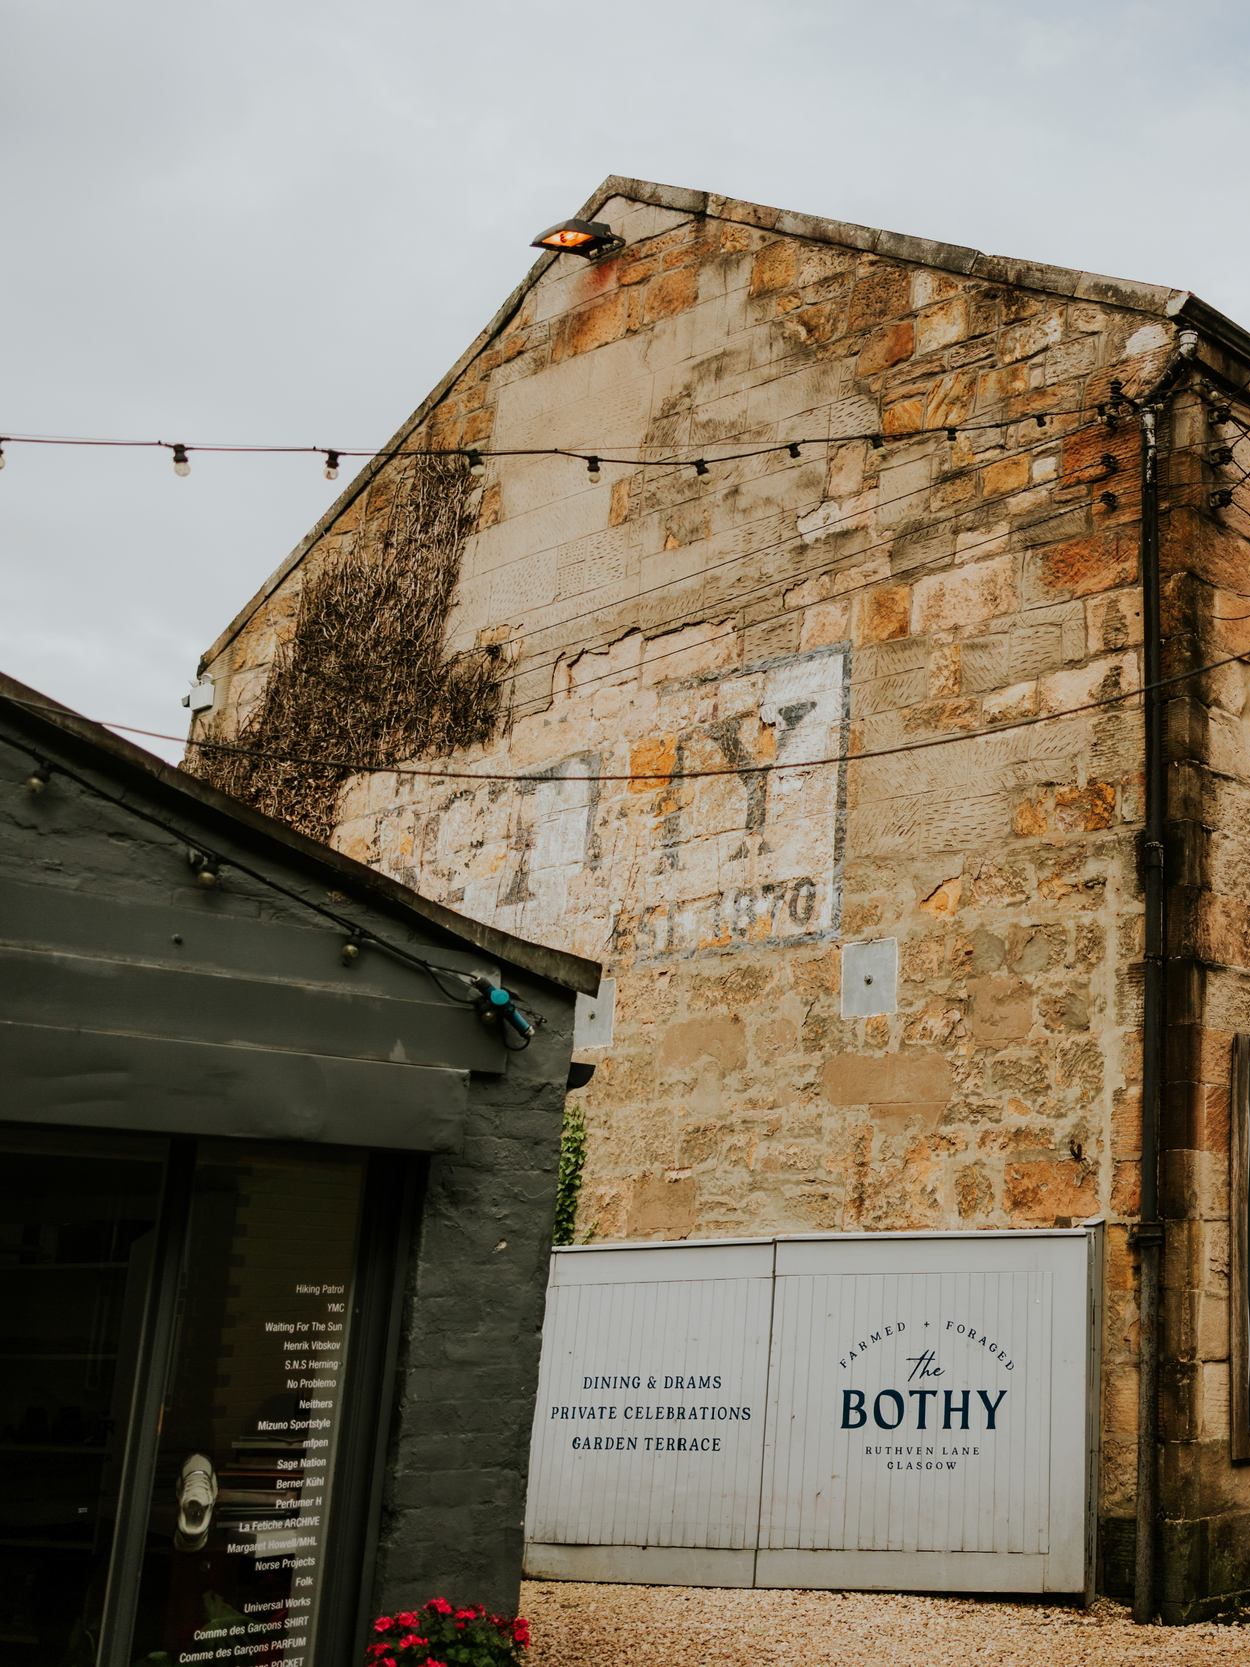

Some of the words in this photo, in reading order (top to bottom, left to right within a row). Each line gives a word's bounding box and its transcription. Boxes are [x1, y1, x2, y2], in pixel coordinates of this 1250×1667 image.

[295, 1284, 321, 1296] Hiking
[321, 1284, 345, 1294] Patrol
[327, 1303, 345, 1313] YMC
[264, 1321, 295, 1334] Waiting
[296, 1321, 310, 1331] For
[311, 1321, 326, 1331] The
[327, 1321, 343, 1331] Sun
[283, 1340, 310, 1351] Henrik
[311, 1340, 341, 1351] Vibskov
[839, 1321, 907, 1369] FARMED
[945, 1320, 1015, 1372] FORAGED
[284, 1359, 307, 1370] S.N.S
[308, 1359, 339, 1371] Herning
[905, 1349, 946, 1382] the
[286, 1379, 299, 1389] No
[299, 1379, 337, 1389] Problemo
[582, 1375, 642, 1390] DINING
[646, 1375, 658, 1389] &
[663, 1375, 723, 1389] DRAMS
[299, 1399, 334, 1410] Neithers
[840, 1388, 1008, 1430] BOTHY
[550, 1406, 618, 1420] PRIVATE
[623, 1406, 752, 1421] CELEBRATIONS
[257, 1420, 289, 1431] Mizuno
[289, 1418, 331, 1430] Sportstyle
[302, 1438, 329, 1449] mfpen
[571, 1436, 638, 1450] GARDEN
[643, 1437, 722, 1451] TERRACE
[865, 1446, 935, 1455] RUTHVEN
[942, 1446, 981, 1456] LANE
[277, 1459, 298, 1471] Sage
[299, 1457, 327, 1468] Nation
[886, 1461, 957, 1470] GLASGOW
[275, 1479, 305, 1489] Berner
[305, 1476, 325, 1487] Kühl
[275, 1498, 314, 1510] Perfumer
[315, 1496, 323, 1506] H
[238, 1522, 251, 1533] La
[284, 1516, 321, 1529] ARCHIVE
[227, 1541, 266, 1554] Margaret
[267, 1535, 318, 1550] Howell/MHL
[255, 1560, 281, 1572] Norse
[281, 1556, 316, 1570] Projects
[295, 1576, 314, 1587] Folk
[243, 1600, 283, 1613] Universal
[284, 1597, 312, 1608] Works
[193, 1627, 228, 1641] Comme
[229, 1623, 246, 1636] des
[247, 1620, 282, 1635] Garçons
[283, 1615, 310, 1628] SHIRT
[179, 1649, 214, 1664] Comme
[215, 1646, 232, 1659] des
[233, 1642, 269, 1657] Garçons
[270, 1636, 307, 1650] PARFUM
